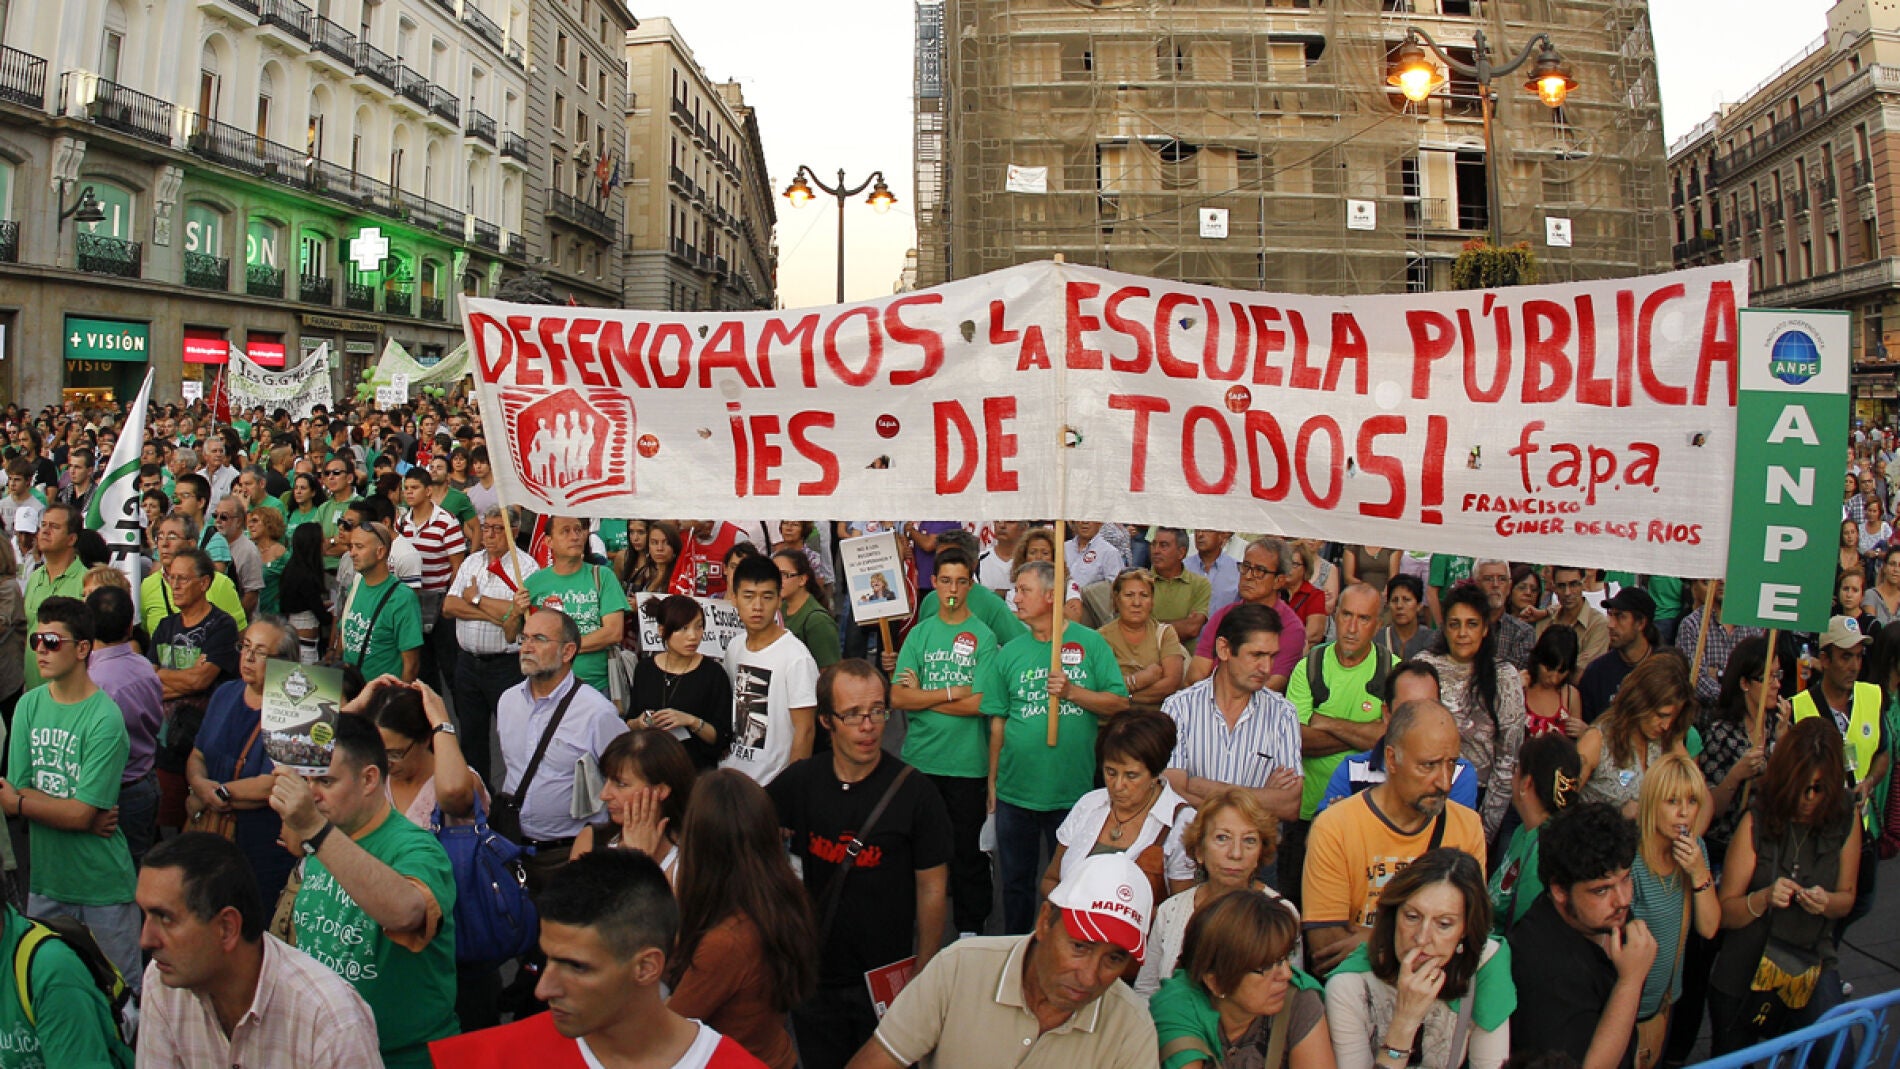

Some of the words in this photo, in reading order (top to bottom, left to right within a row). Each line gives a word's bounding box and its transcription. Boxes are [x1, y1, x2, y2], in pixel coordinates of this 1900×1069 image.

[86, 329, 145, 351] VISIÓN
[469, 294, 945, 389] DEFENDAMOS
[989, 300, 1052, 371] LA
[1065, 281, 1369, 396] ESCUELA
[1404, 280, 1741, 408] PÚBLICA
[1776, 362, 1817, 375] ANPE
[933, 396, 1020, 496] DE
[1108, 393, 1449, 526] TODOS!
[1461, 493, 1581, 514] FRANCISCO
[1757, 405, 1821, 622] ANPE
[1495, 514, 1565, 537] GINER
[1647, 519, 1703, 545] RIOS
[1091, 900, 1144, 926] MAPFRE
